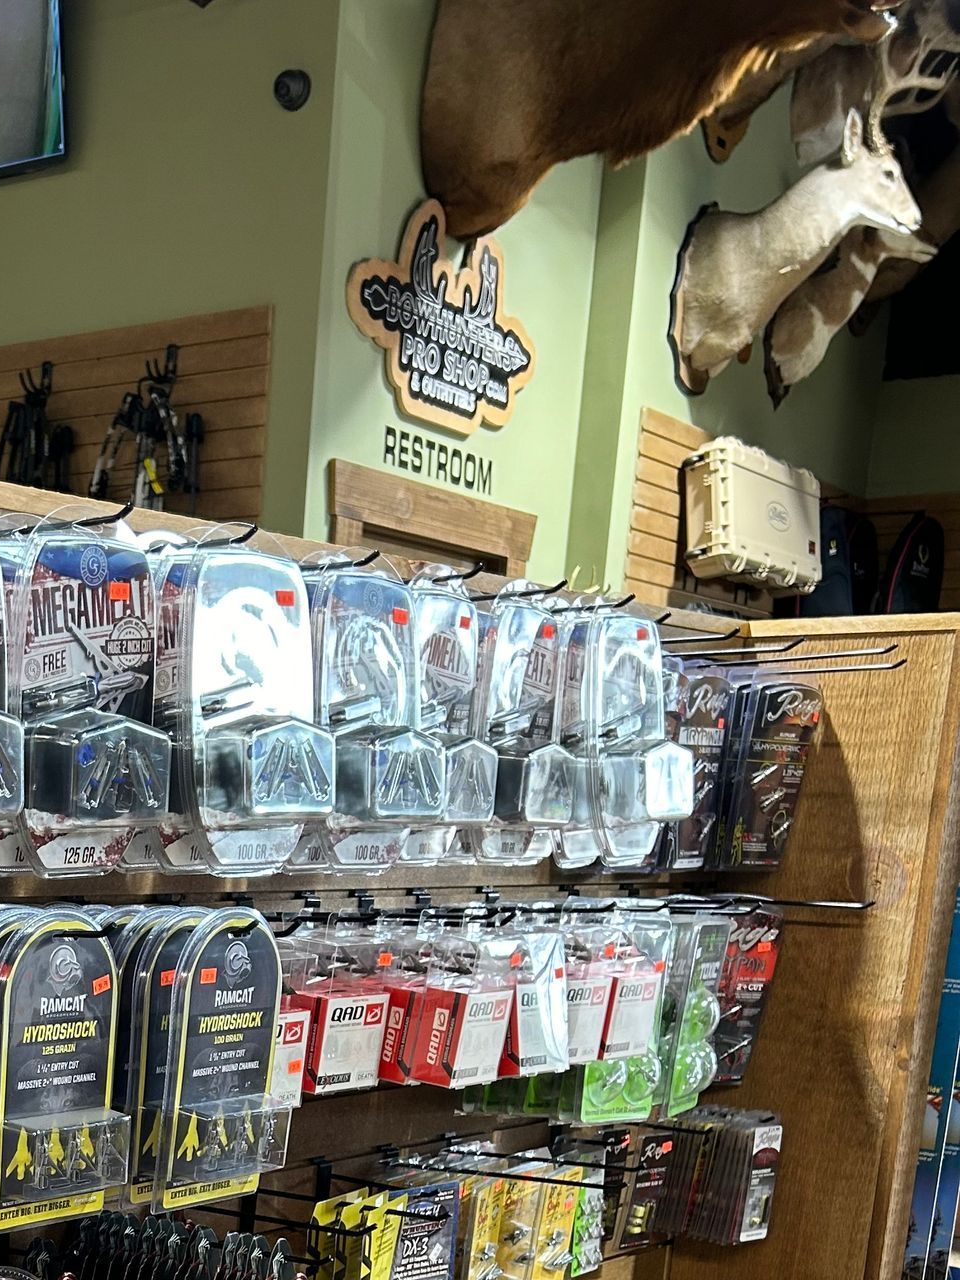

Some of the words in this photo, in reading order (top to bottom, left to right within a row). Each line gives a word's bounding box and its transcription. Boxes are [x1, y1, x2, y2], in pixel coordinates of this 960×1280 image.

[402, 333, 440, 375] PRO
[443, 350, 489, 393] SHOP
[383, 425, 493, 495] RESTROOM
[42, 651, 66, 673] FREE
[64, 847, 80, 864] 125
[81, 847, 97, 863] GR.
[214, 987, 255, 1007] RAMCAT
[521, 992, 539, 1007] QA
[567, 988, 590, 1001] QAD
[619, 985, 642, 998] QAD
[40, 994, 87, 1016] RAMCAT
[331, 1005, 365, 1023] QAD
[468, 1001, 494, 1017] QAD
[23, 1020, 98, 1043] HYDROSHOCK
[199, 1011, 263, 1033] HYDROSHOCK
[214, 1035, 225, 1044] 100
[225, 1033, 244, 1043] GRAIN
[382, 1028, 396, 1062] QAD
[426, 1029, 441, 1065] QAD
[42, 1046, 54, 1056] 125
[55, 1043, 77, 1054] GRAIN
[0, 1211, 20, 1221] ENTER
[20, 1208, 33, 1218] BIG.
[33, 1204, 47, 1215] EXIT
[48, 1200, 72, 1212] BIGGER.
[403, 1237, 429, 1258] DX-3
